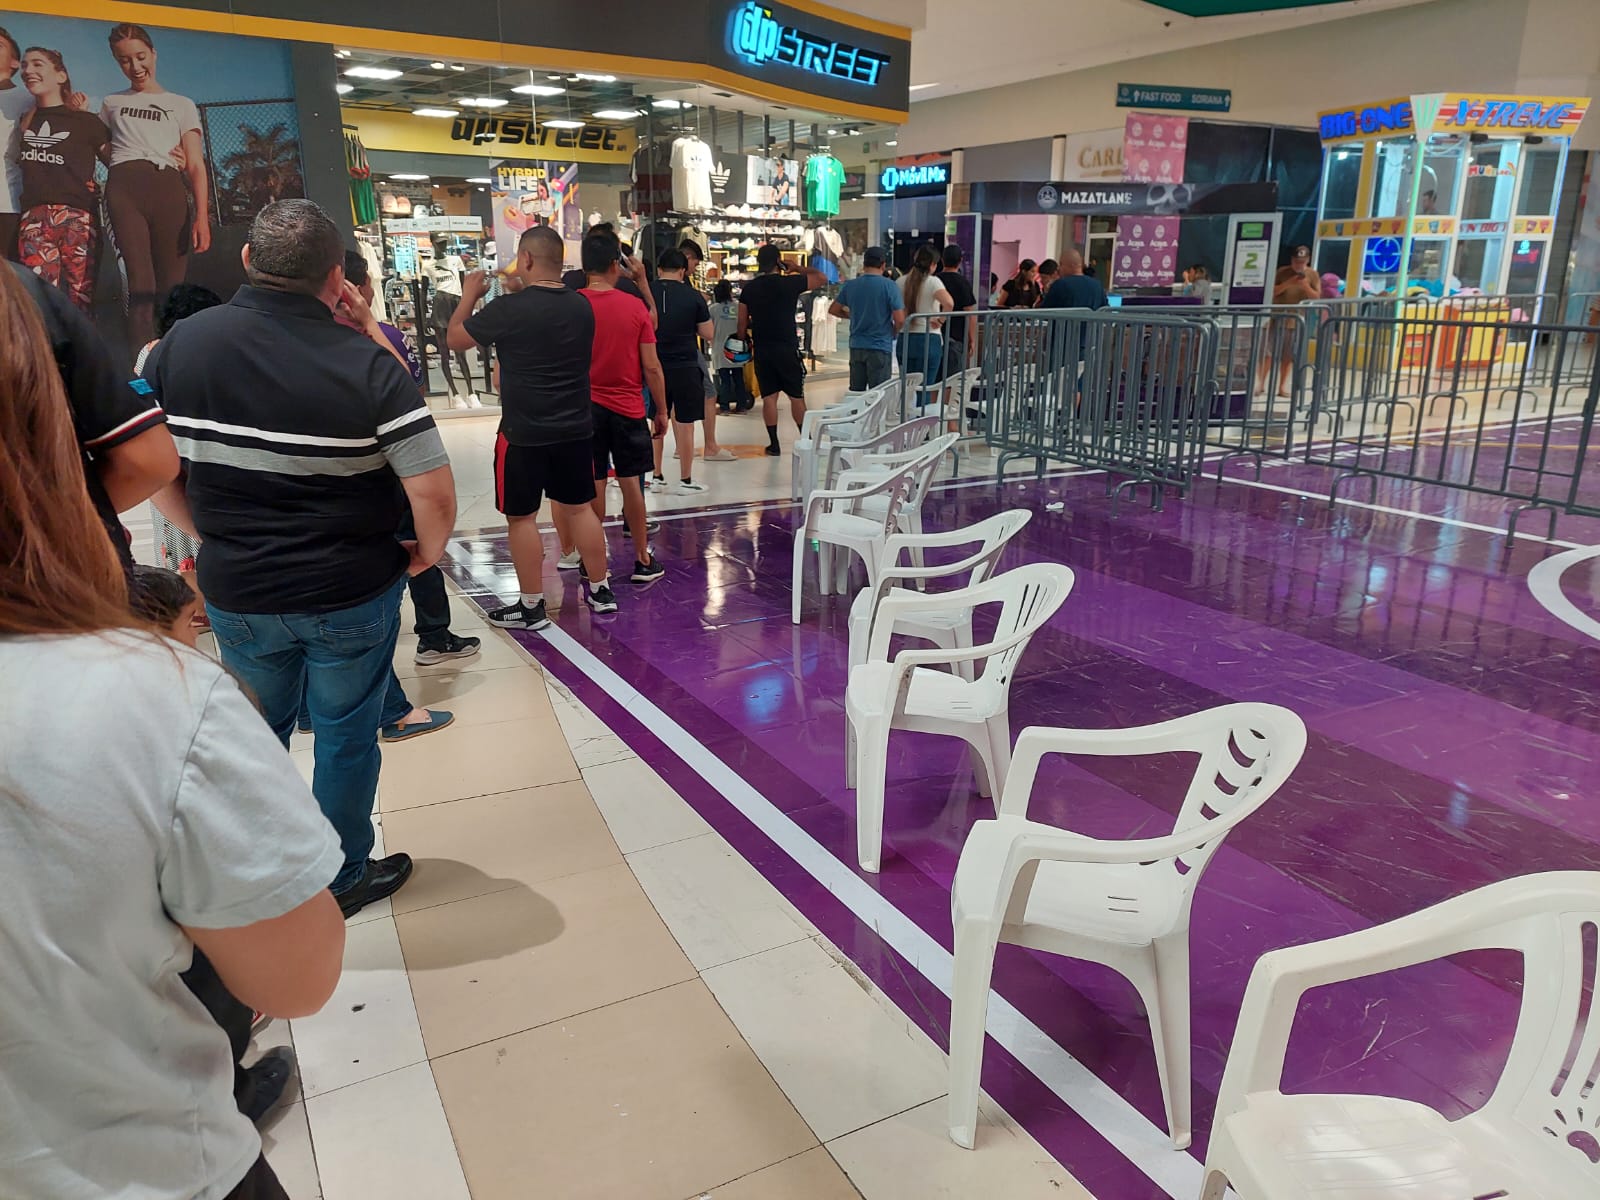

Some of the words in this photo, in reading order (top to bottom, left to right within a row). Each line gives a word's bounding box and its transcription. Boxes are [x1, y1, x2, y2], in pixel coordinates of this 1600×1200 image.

[1140, 91, 1159, 102] FAST
[1160, 92, 1181, 103] FOOD
[1191, 94, 1223, 105] SORIANA
[120, 107, 162, 122] PUMA
[1320, 111, 1357, 140] BIG
[1359, 102, 1411, 134] ONE
[1445, 99, 1576, 128] X-TREME
[497, 167, 546, 179] HYBRID
[498, 175, 538, 192] LIFE
[1243, 252, 1258, 269] 2
[503, 611, 522, 621] PUMA
